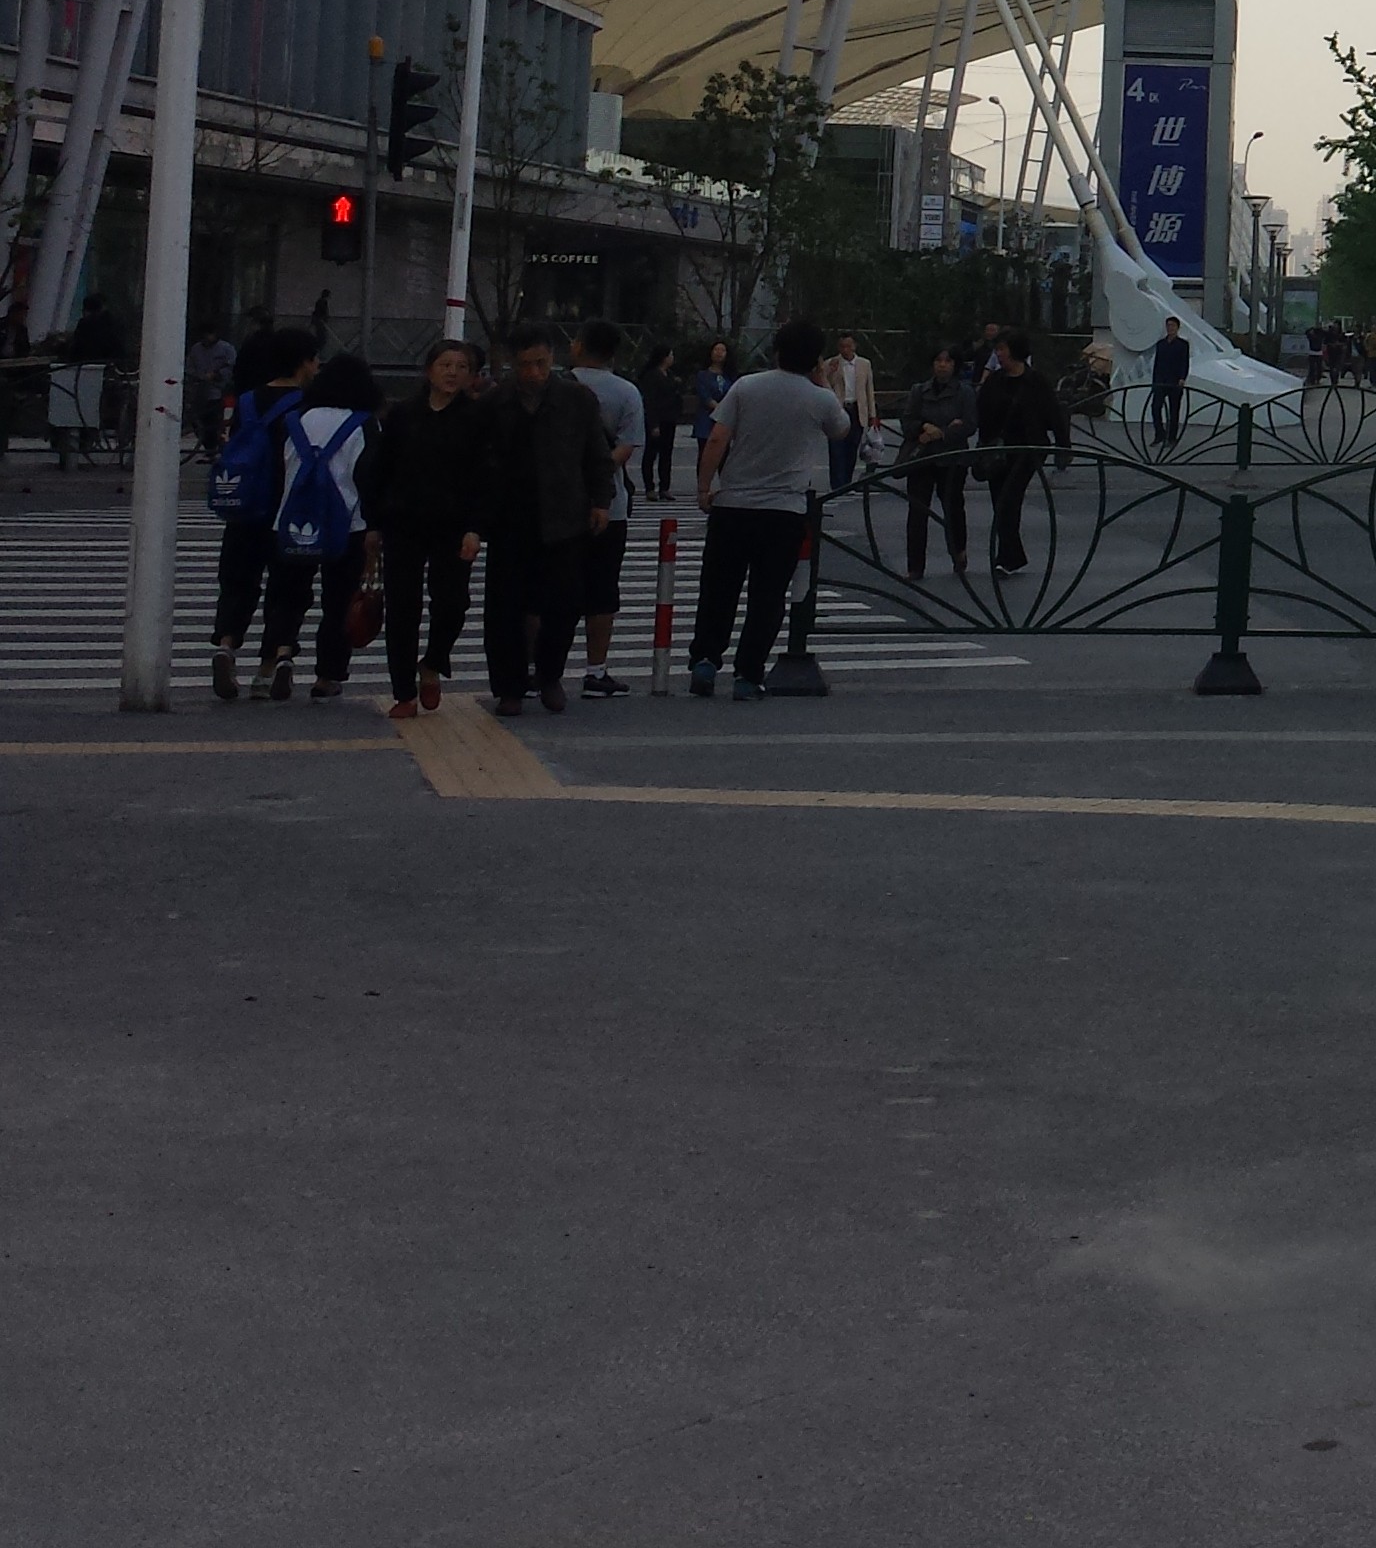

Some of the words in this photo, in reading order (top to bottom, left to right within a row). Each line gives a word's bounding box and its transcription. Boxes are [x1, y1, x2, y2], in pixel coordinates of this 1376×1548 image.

[1145, 116, 1187, 244] 世博源
[551, 254, 599, 264] COFFEE
